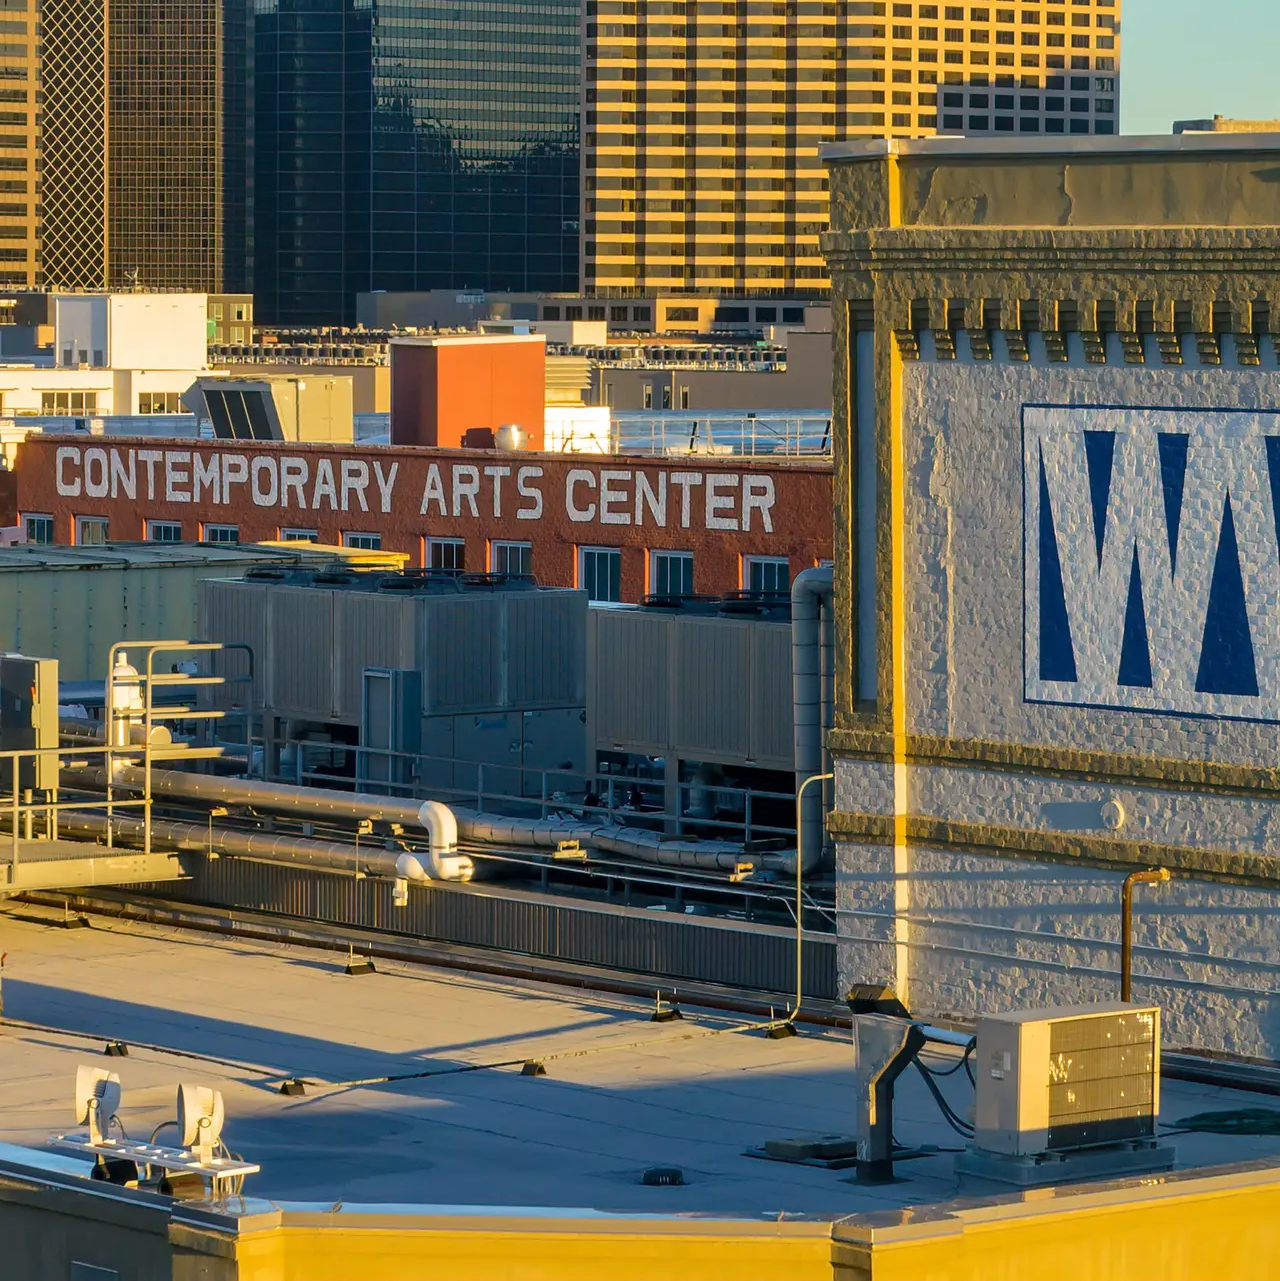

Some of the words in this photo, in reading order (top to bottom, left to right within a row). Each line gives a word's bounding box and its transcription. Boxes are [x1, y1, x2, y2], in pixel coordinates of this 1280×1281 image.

[55, 445, 400, 514] CONTEMPORARY
[420, 463, 543, 520] ARTS
[565, 468, 778, 534] CENTER
